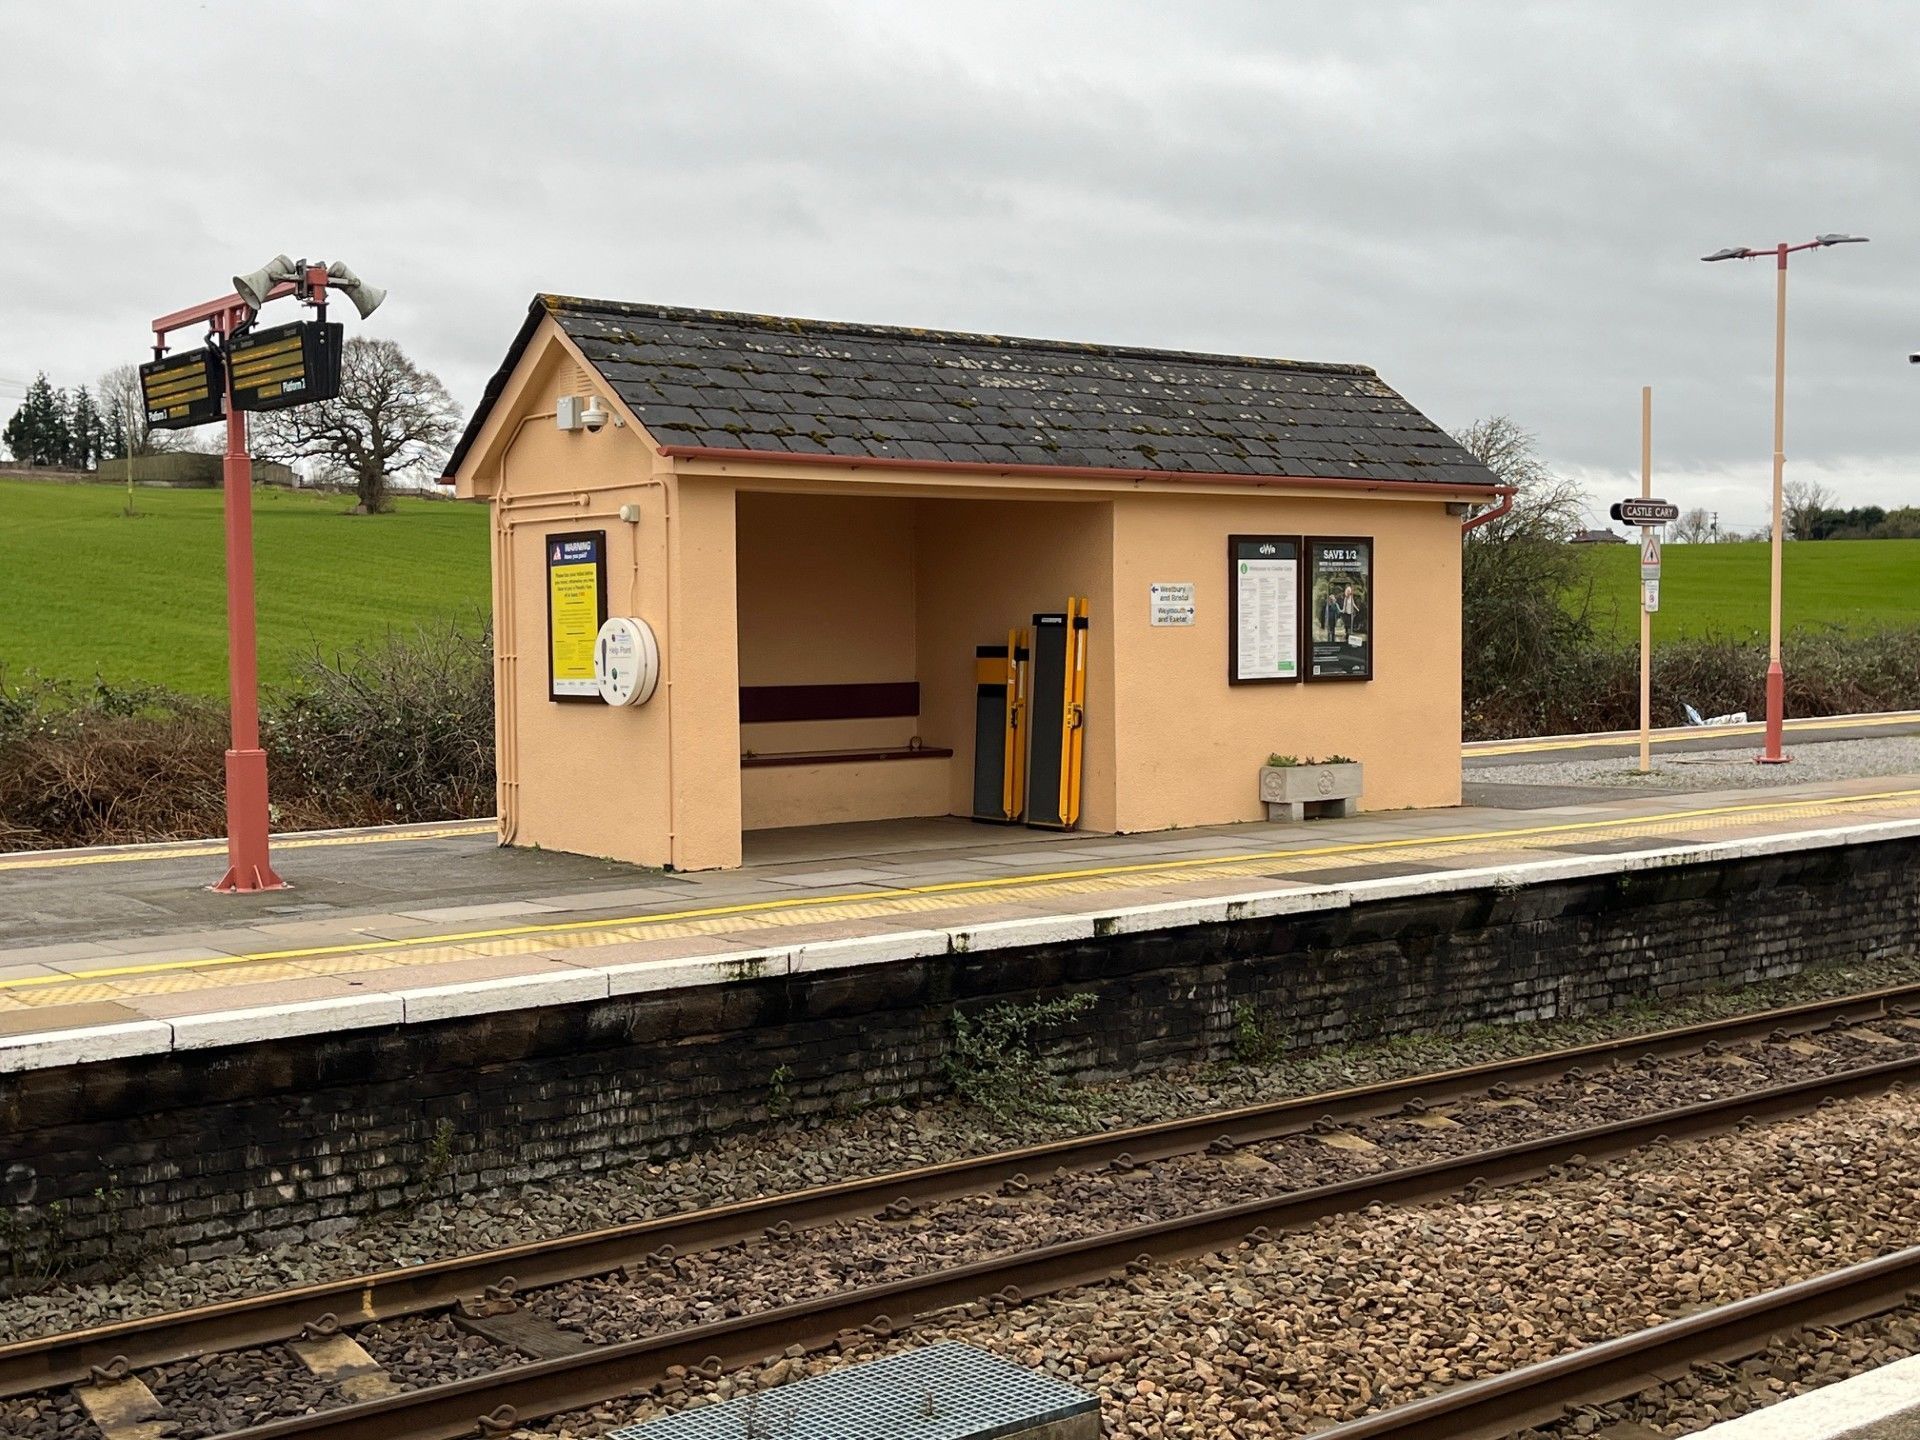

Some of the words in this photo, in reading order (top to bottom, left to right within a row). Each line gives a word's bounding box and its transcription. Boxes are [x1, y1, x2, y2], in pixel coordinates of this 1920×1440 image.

[282, 380, 301, 393] Platform
[1626, 506, 1653, 517] CASTLE
[1655, 507, 1674, 518] CARY
[564, 541, 592, 553] WARNING
[1259, 543, 1277, 555] GWR
[1323, 549, 1345, 560] SAVE
[1345, 550, 1358, 560] 1/3
[1160, 594, 1171, 602] and
[1171, 594, 1189, 602] Bristol
[1169, 615, 1188, 623] Exeter
